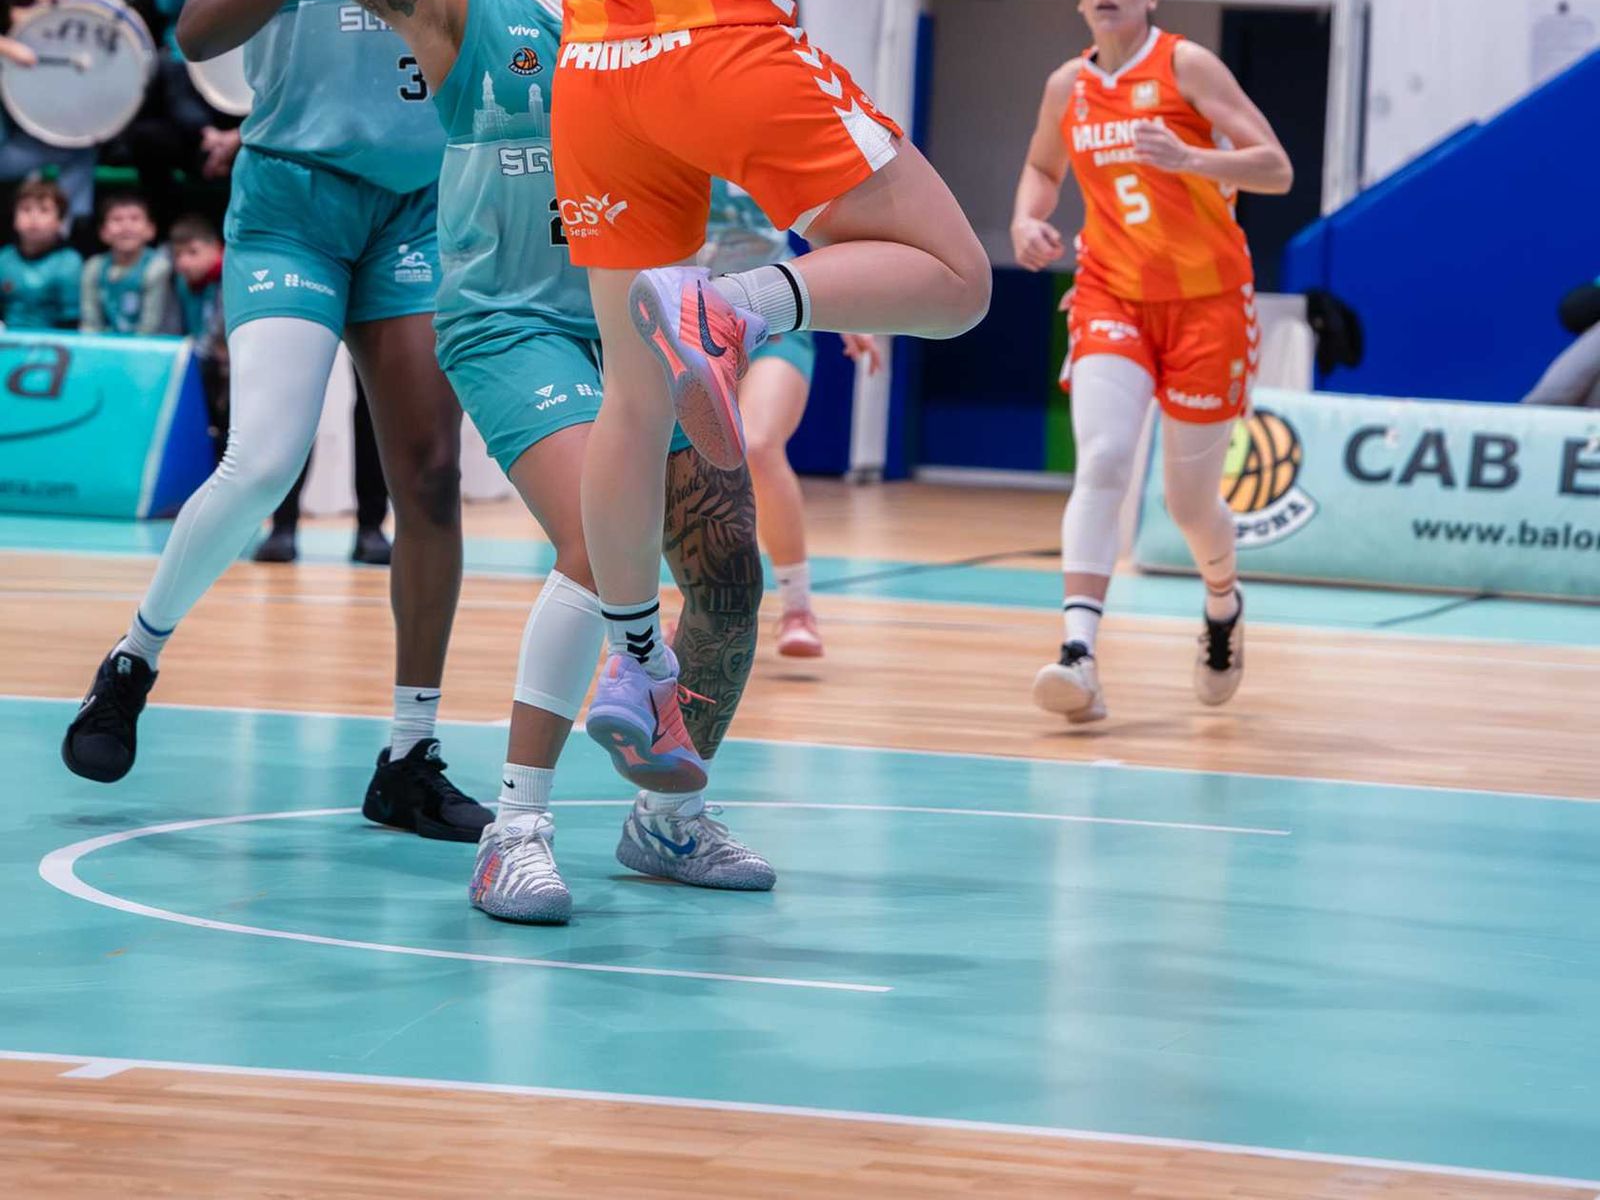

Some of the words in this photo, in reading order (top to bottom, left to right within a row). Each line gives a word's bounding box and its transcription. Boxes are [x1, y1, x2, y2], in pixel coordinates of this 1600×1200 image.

[508, 24, 540, 38] vive
[1072, 116, 1165, 152] VALENC
[1114, 174, 1151, 224] 5
[536, 393, 568, 411] vive
[1343, 424, 1521, 491] CAB
